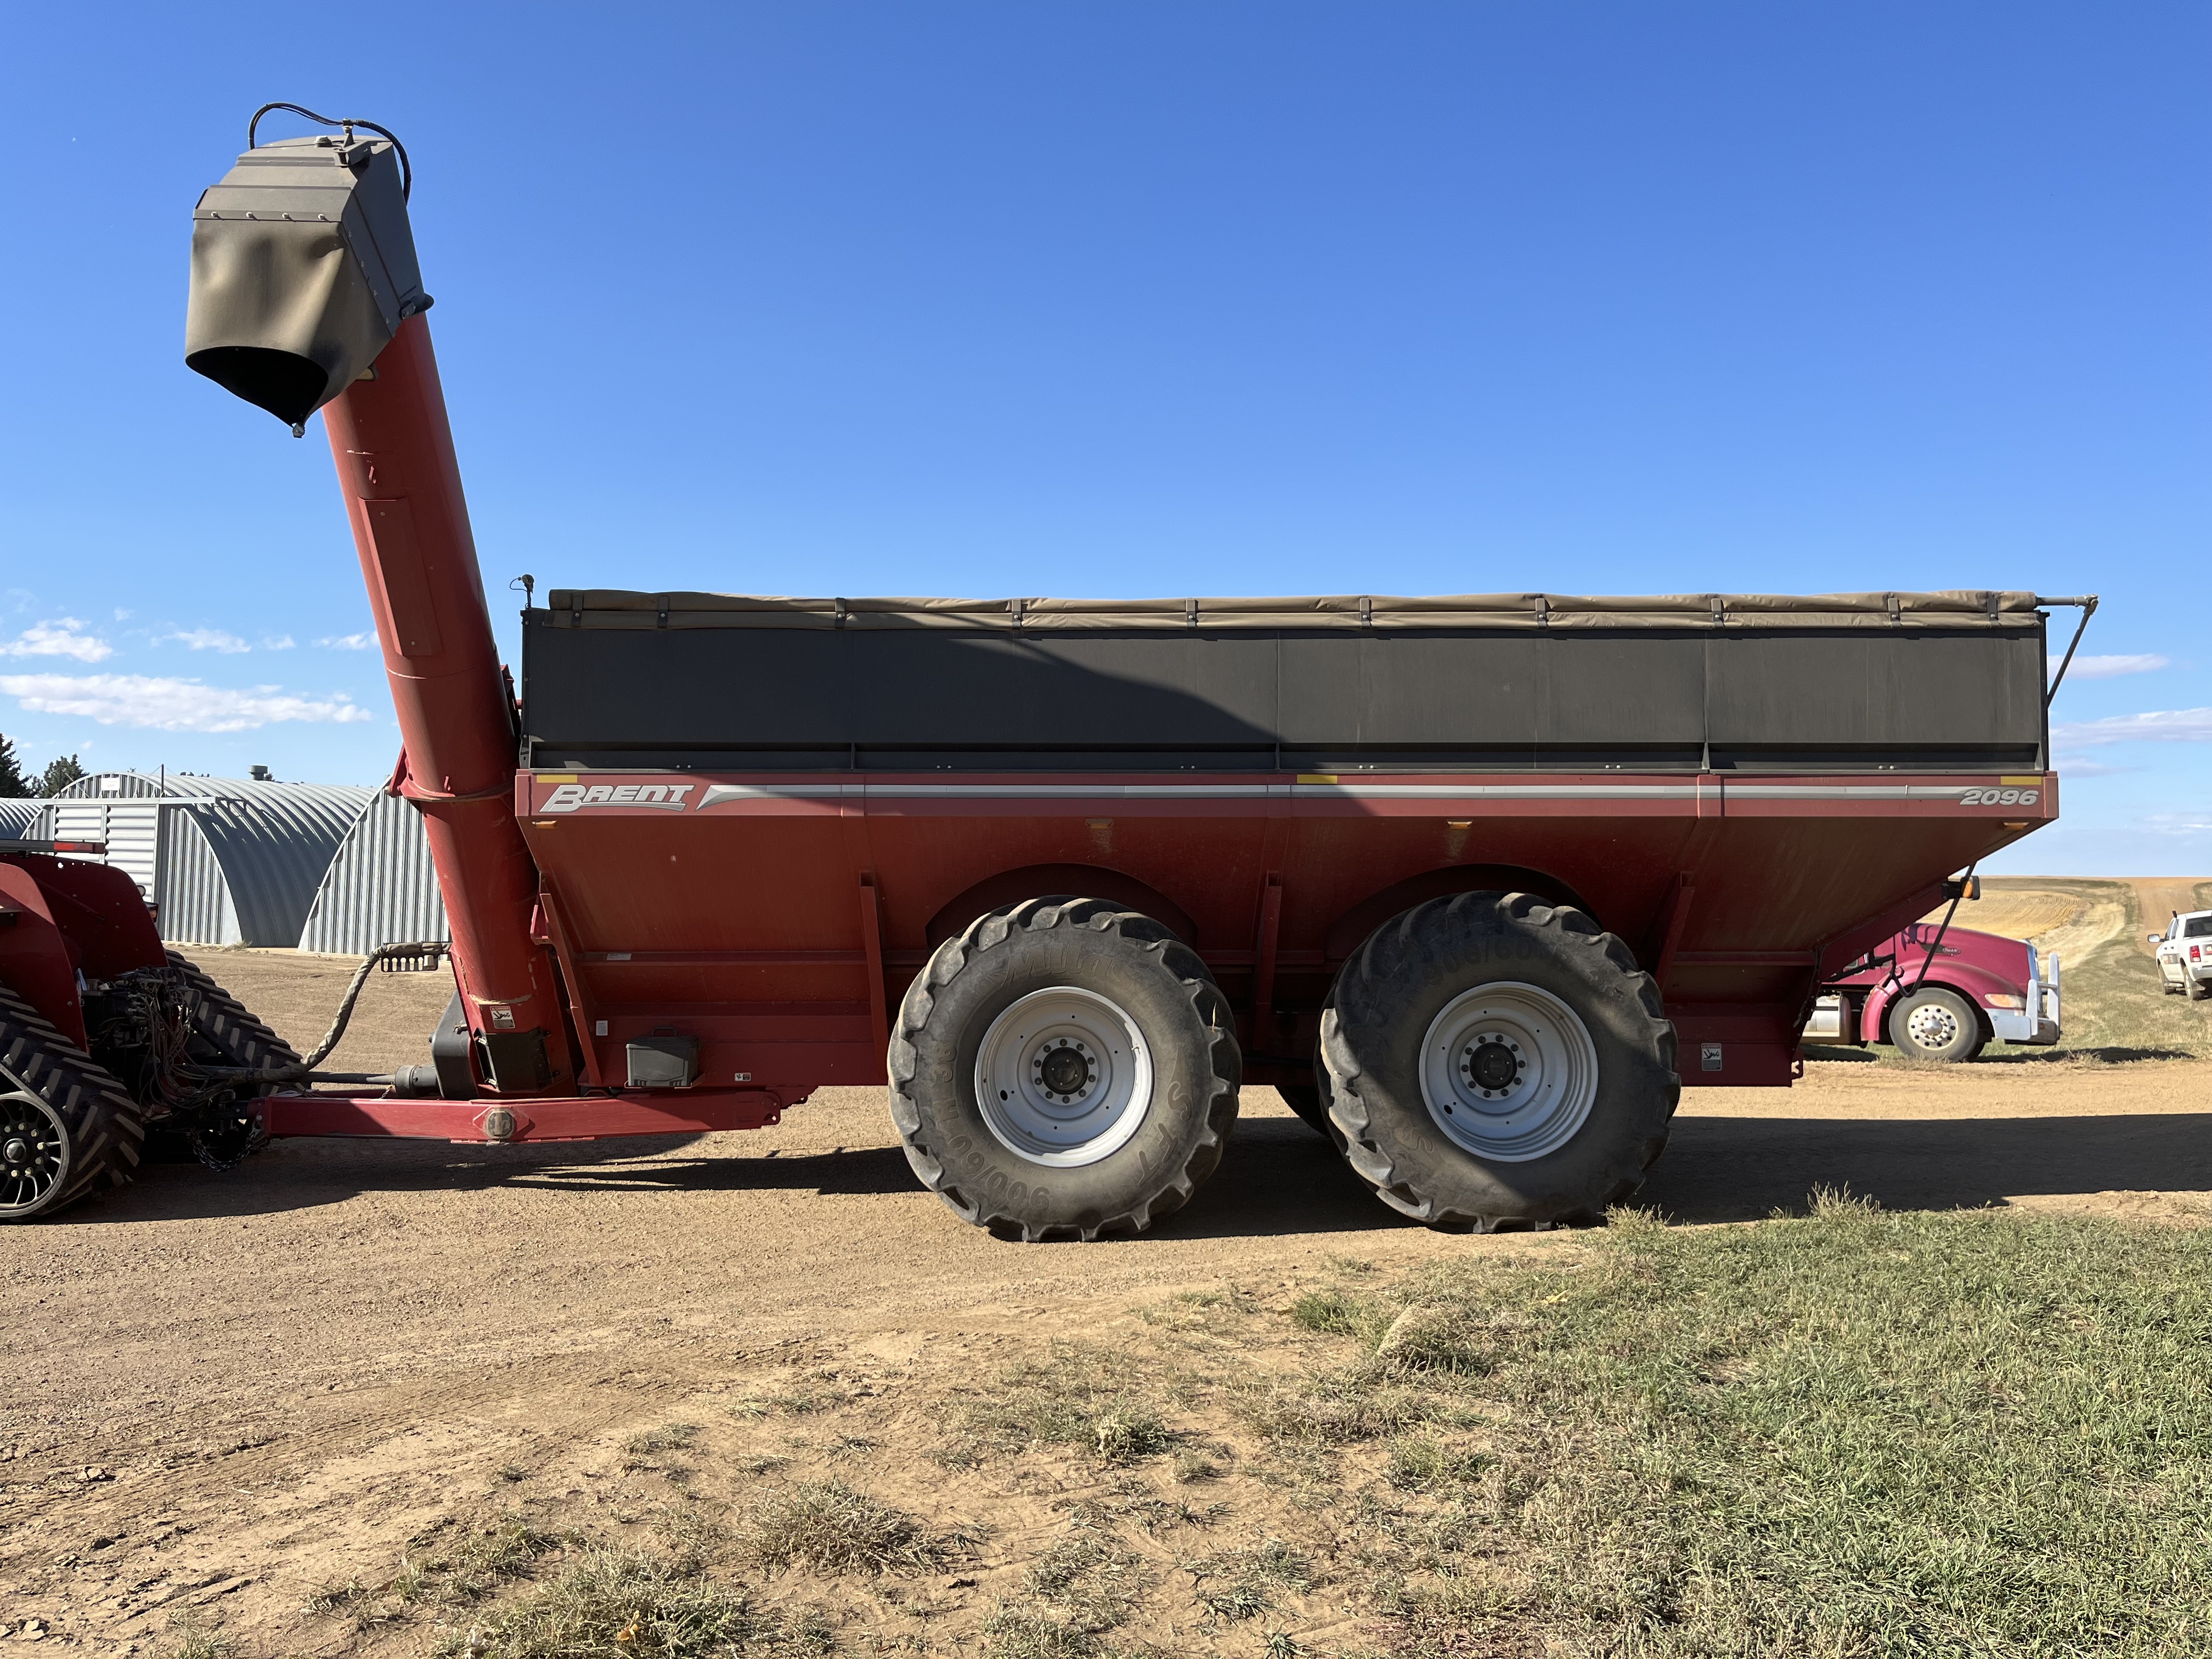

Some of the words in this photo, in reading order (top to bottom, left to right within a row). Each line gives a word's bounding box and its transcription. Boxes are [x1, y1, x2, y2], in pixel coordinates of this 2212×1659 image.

[539, 785, 695, 812] BRENT
[1960, 790, 2039, 805] 2096
[930, 1040, 956, 1082] 38
[935, 1098, 959, 1120] R
[949, 1135, 1050, 1210] 900/60
